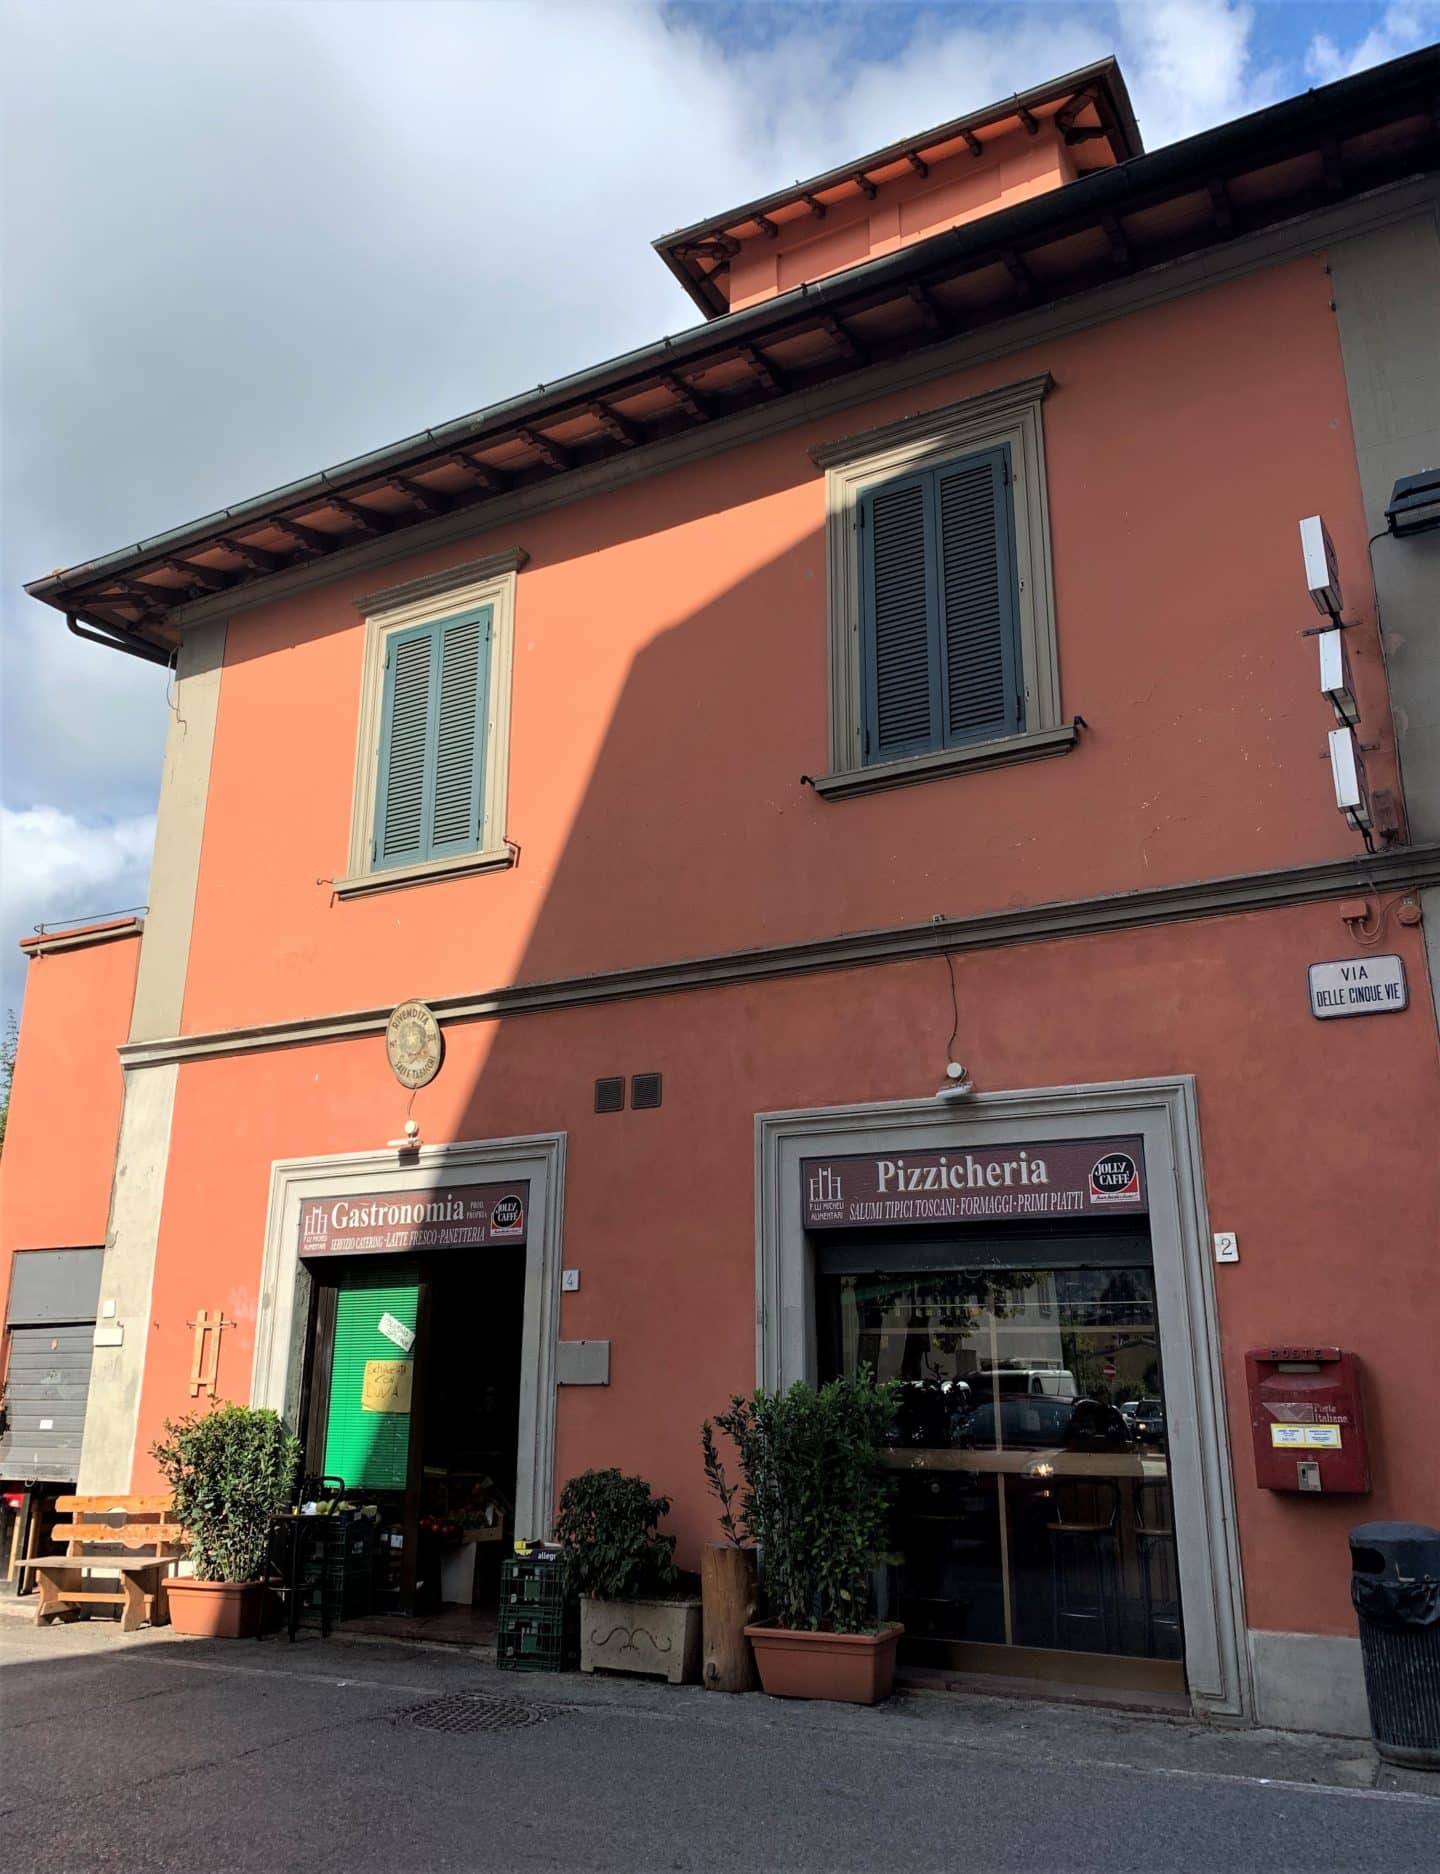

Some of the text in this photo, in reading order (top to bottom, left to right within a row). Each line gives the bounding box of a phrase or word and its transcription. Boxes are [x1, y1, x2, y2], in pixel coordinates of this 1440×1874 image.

[1341, 966, 1368, 981] VIA
[1316, 983, 1401, 1007] DELLE CINQUE VIE
[391, 1007, 429, 1030] RIVENDITA
[875, 1151, 1049, 1193] Pizzicheria
[1094, 1162, 1127, 1176] JOLLY
[331, 1193, 464, 1229] Gastronomia
[495, 1202, 518, 1214] JOLLY
[849, 1201, 883, 1220] SALUMI
[884, 1200, 913, 1219] TIPICI
[1051, 1191, 1083, 1210] PIATTI
[1221, 1238, 1232, 1255] 2
[537, 1552, 557, 1561] allegr
